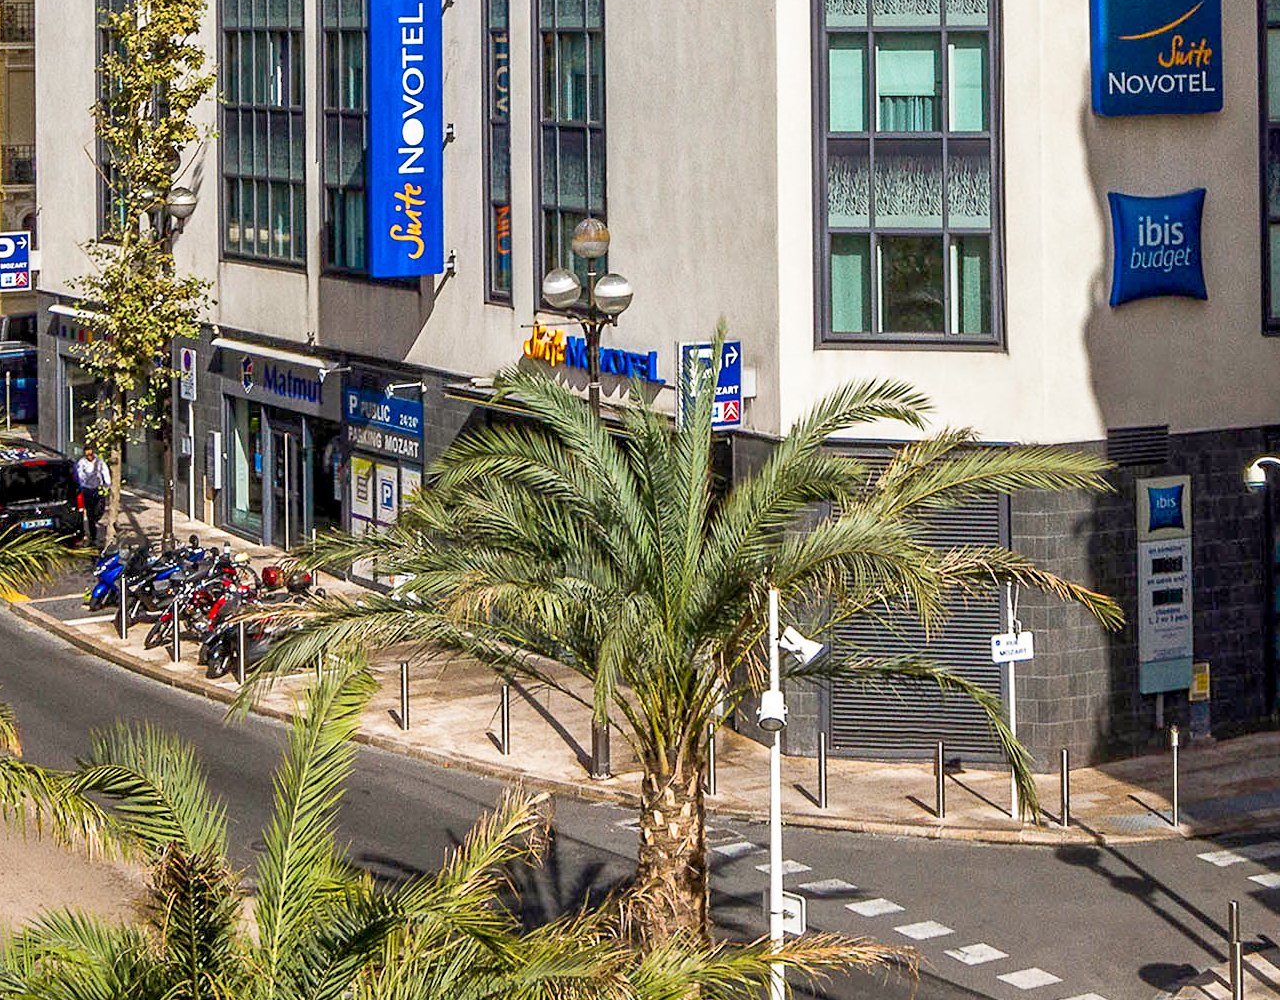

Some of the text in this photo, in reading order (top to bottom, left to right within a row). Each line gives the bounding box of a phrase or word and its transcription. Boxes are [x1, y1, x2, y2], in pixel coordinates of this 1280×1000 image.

[1158, 34, 1213, 68] Suite
[1108, 71, 1216, 95] NOVOTEL
[390, 3, 426, 259] Suite NOVOTEL
[1138, 215, 1185, 247] ibis
[0, 262, 27, 270] MOZART
[1130, 247, 1192, 273] budget
[263, 362, 324, 405] Matmut
[349, 394, 358, 415] P
[361, 401, 391, 423] PUBLIC
[347, 425, 419, 459] PARKING MOZART
